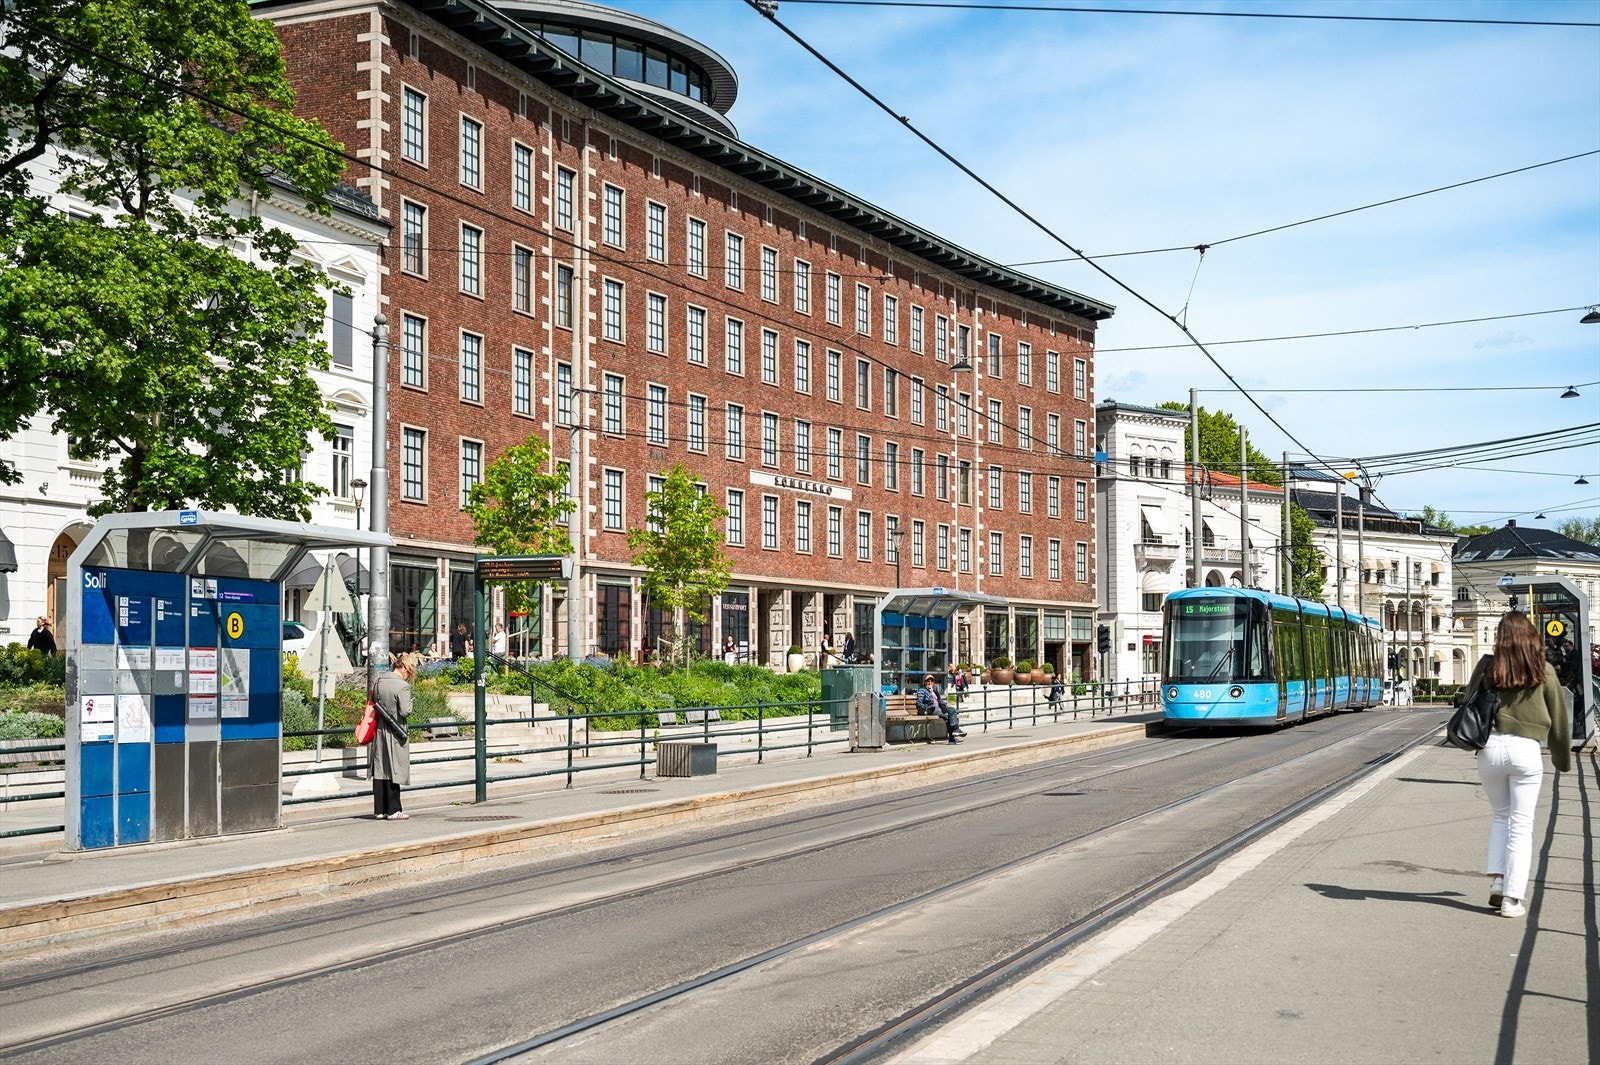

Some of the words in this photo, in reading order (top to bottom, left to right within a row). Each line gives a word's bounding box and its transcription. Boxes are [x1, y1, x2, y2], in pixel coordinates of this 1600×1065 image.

[85, 572, 106, 588] Solli
[1185, 605, 1194, 614] 15
[231, 617, 239, 632] B
[1551, 624, 1559, 633] A
[1193, 690, 1211, 699] 480
